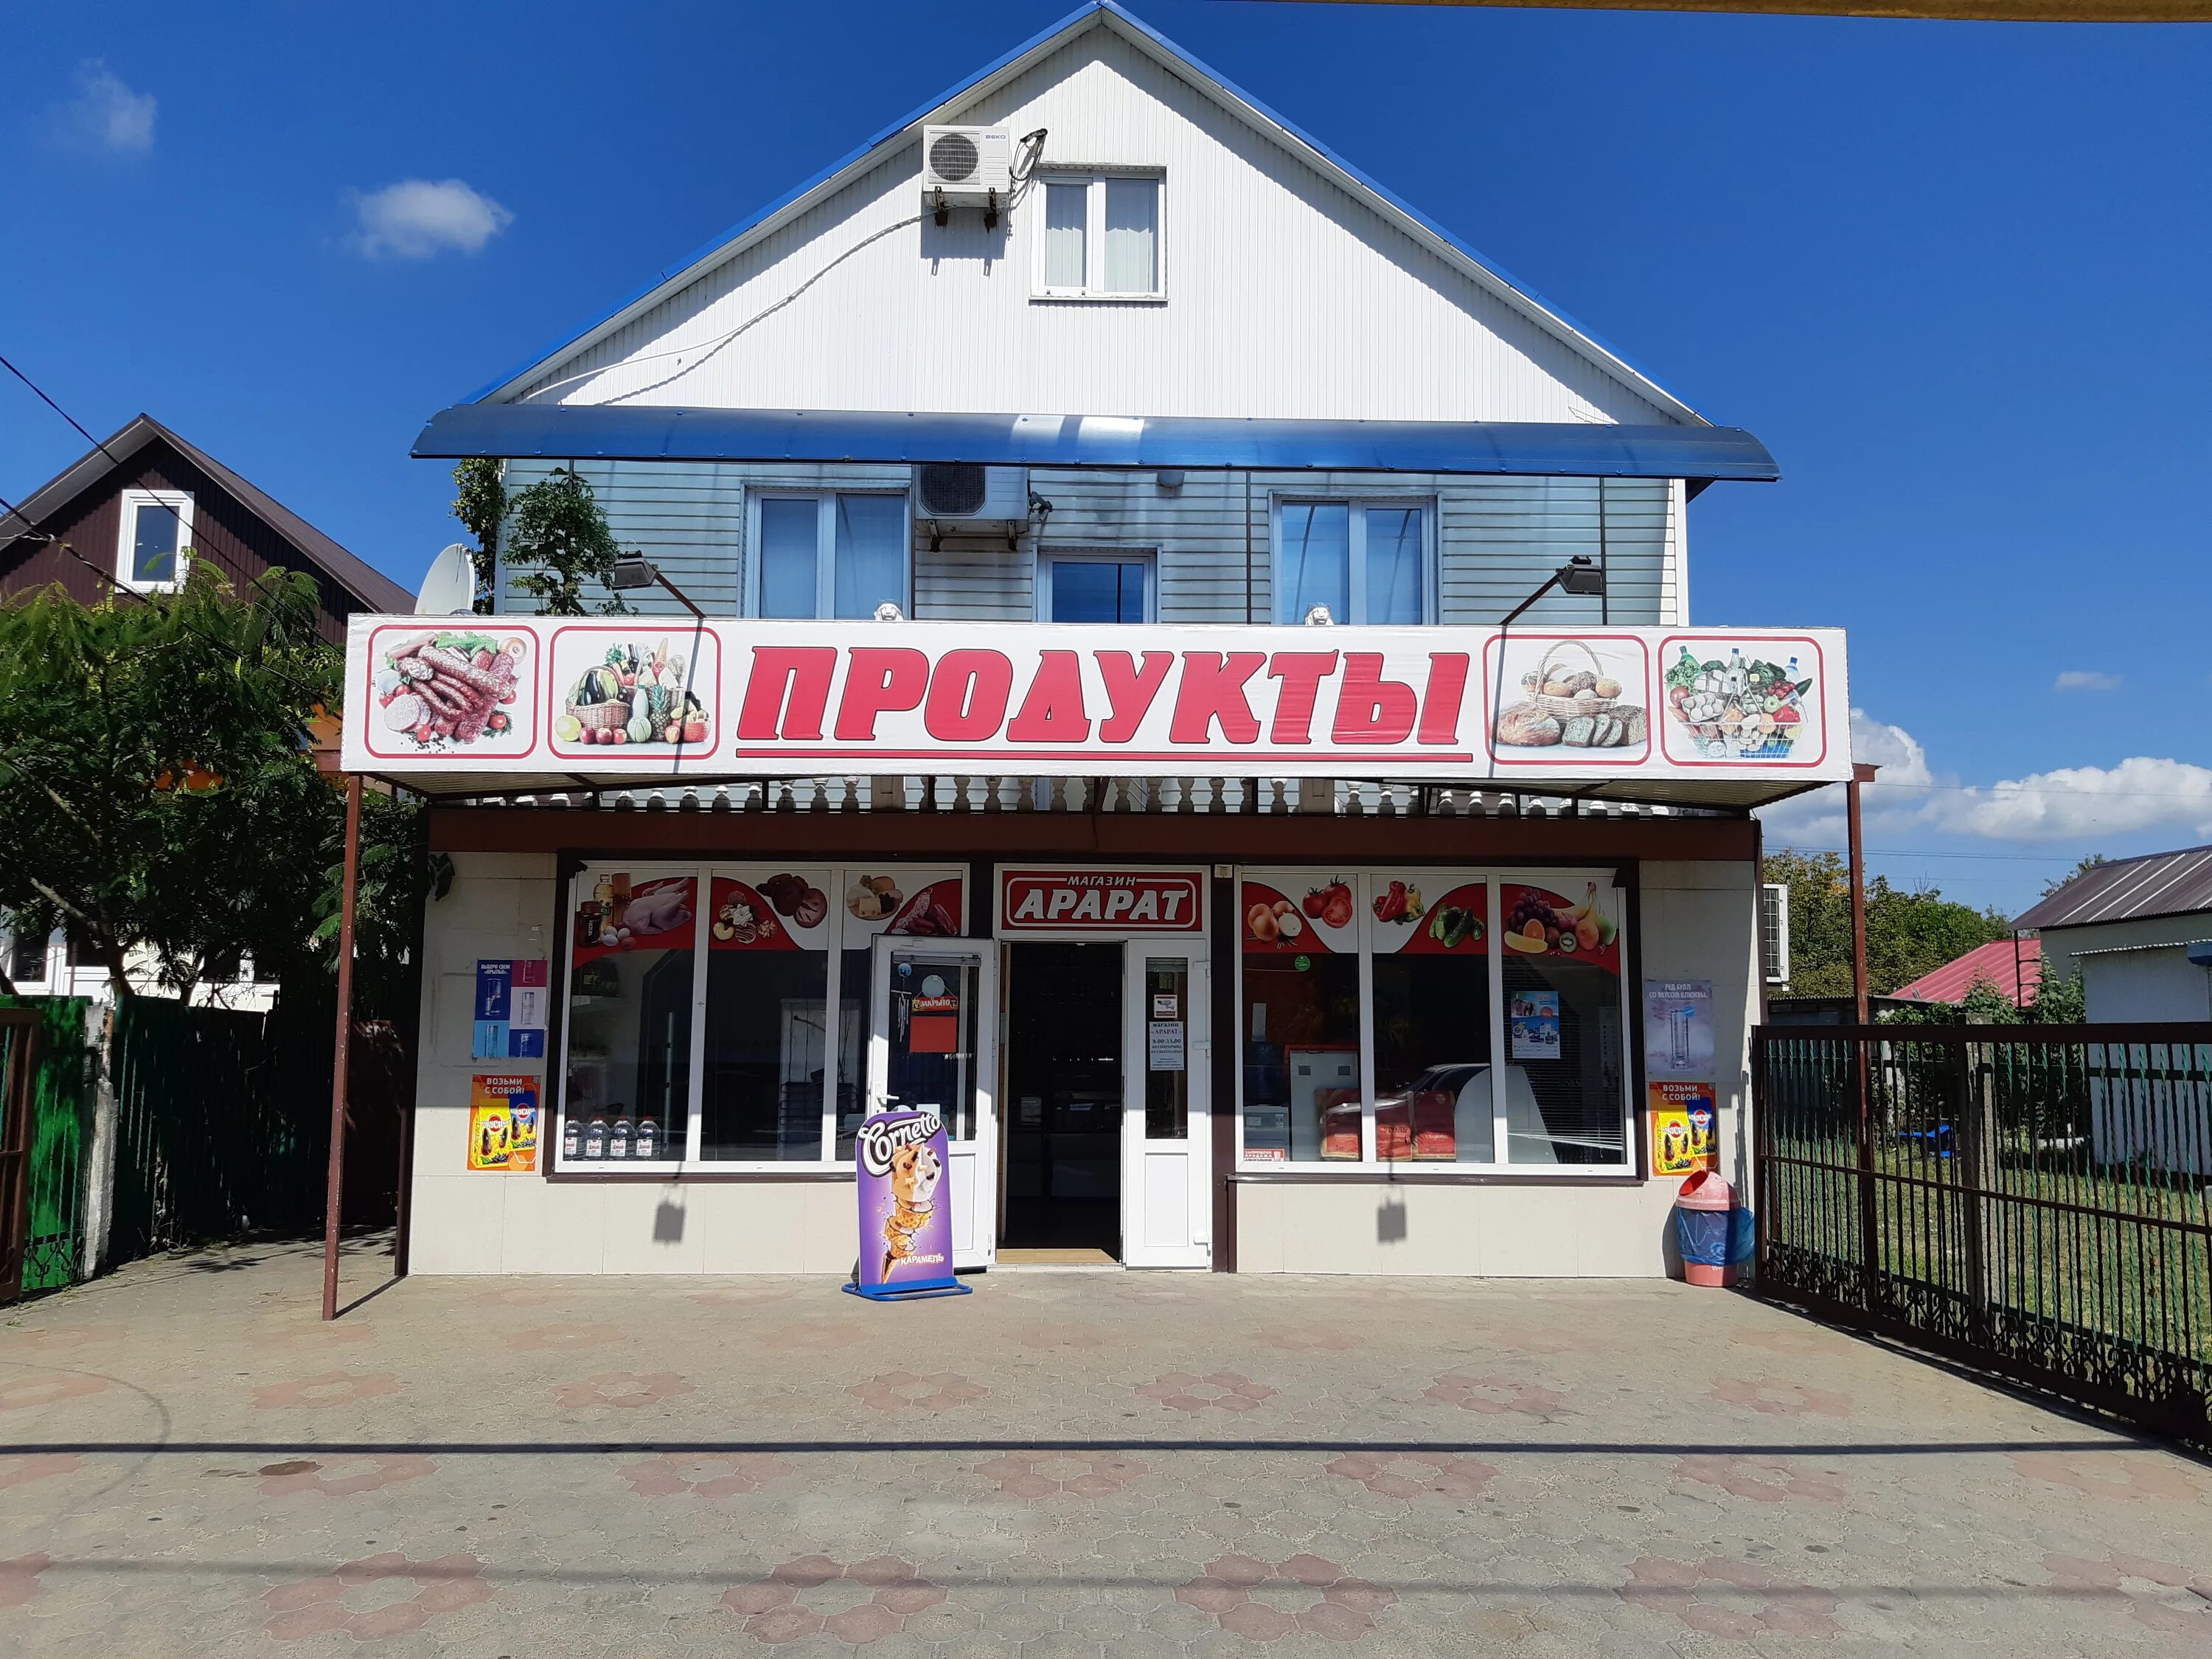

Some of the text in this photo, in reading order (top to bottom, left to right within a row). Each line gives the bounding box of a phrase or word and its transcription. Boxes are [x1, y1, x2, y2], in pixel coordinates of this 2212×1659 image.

[737, 645, 1470, 745] ПРОДУКТЫ
[1068, 876, 1136, 886] МАГАЗИН
[1014, 888, 1189, 920] АРАРАТ
[920, 999, 950, 1007] ЗАКРЫТО
[492, 1086, 524, 1094] СОБОЙ!
[858, 1113, 940, 1175] Cornetto
[900, 1254, 945, 1265] КАРАМЕЛЬ
